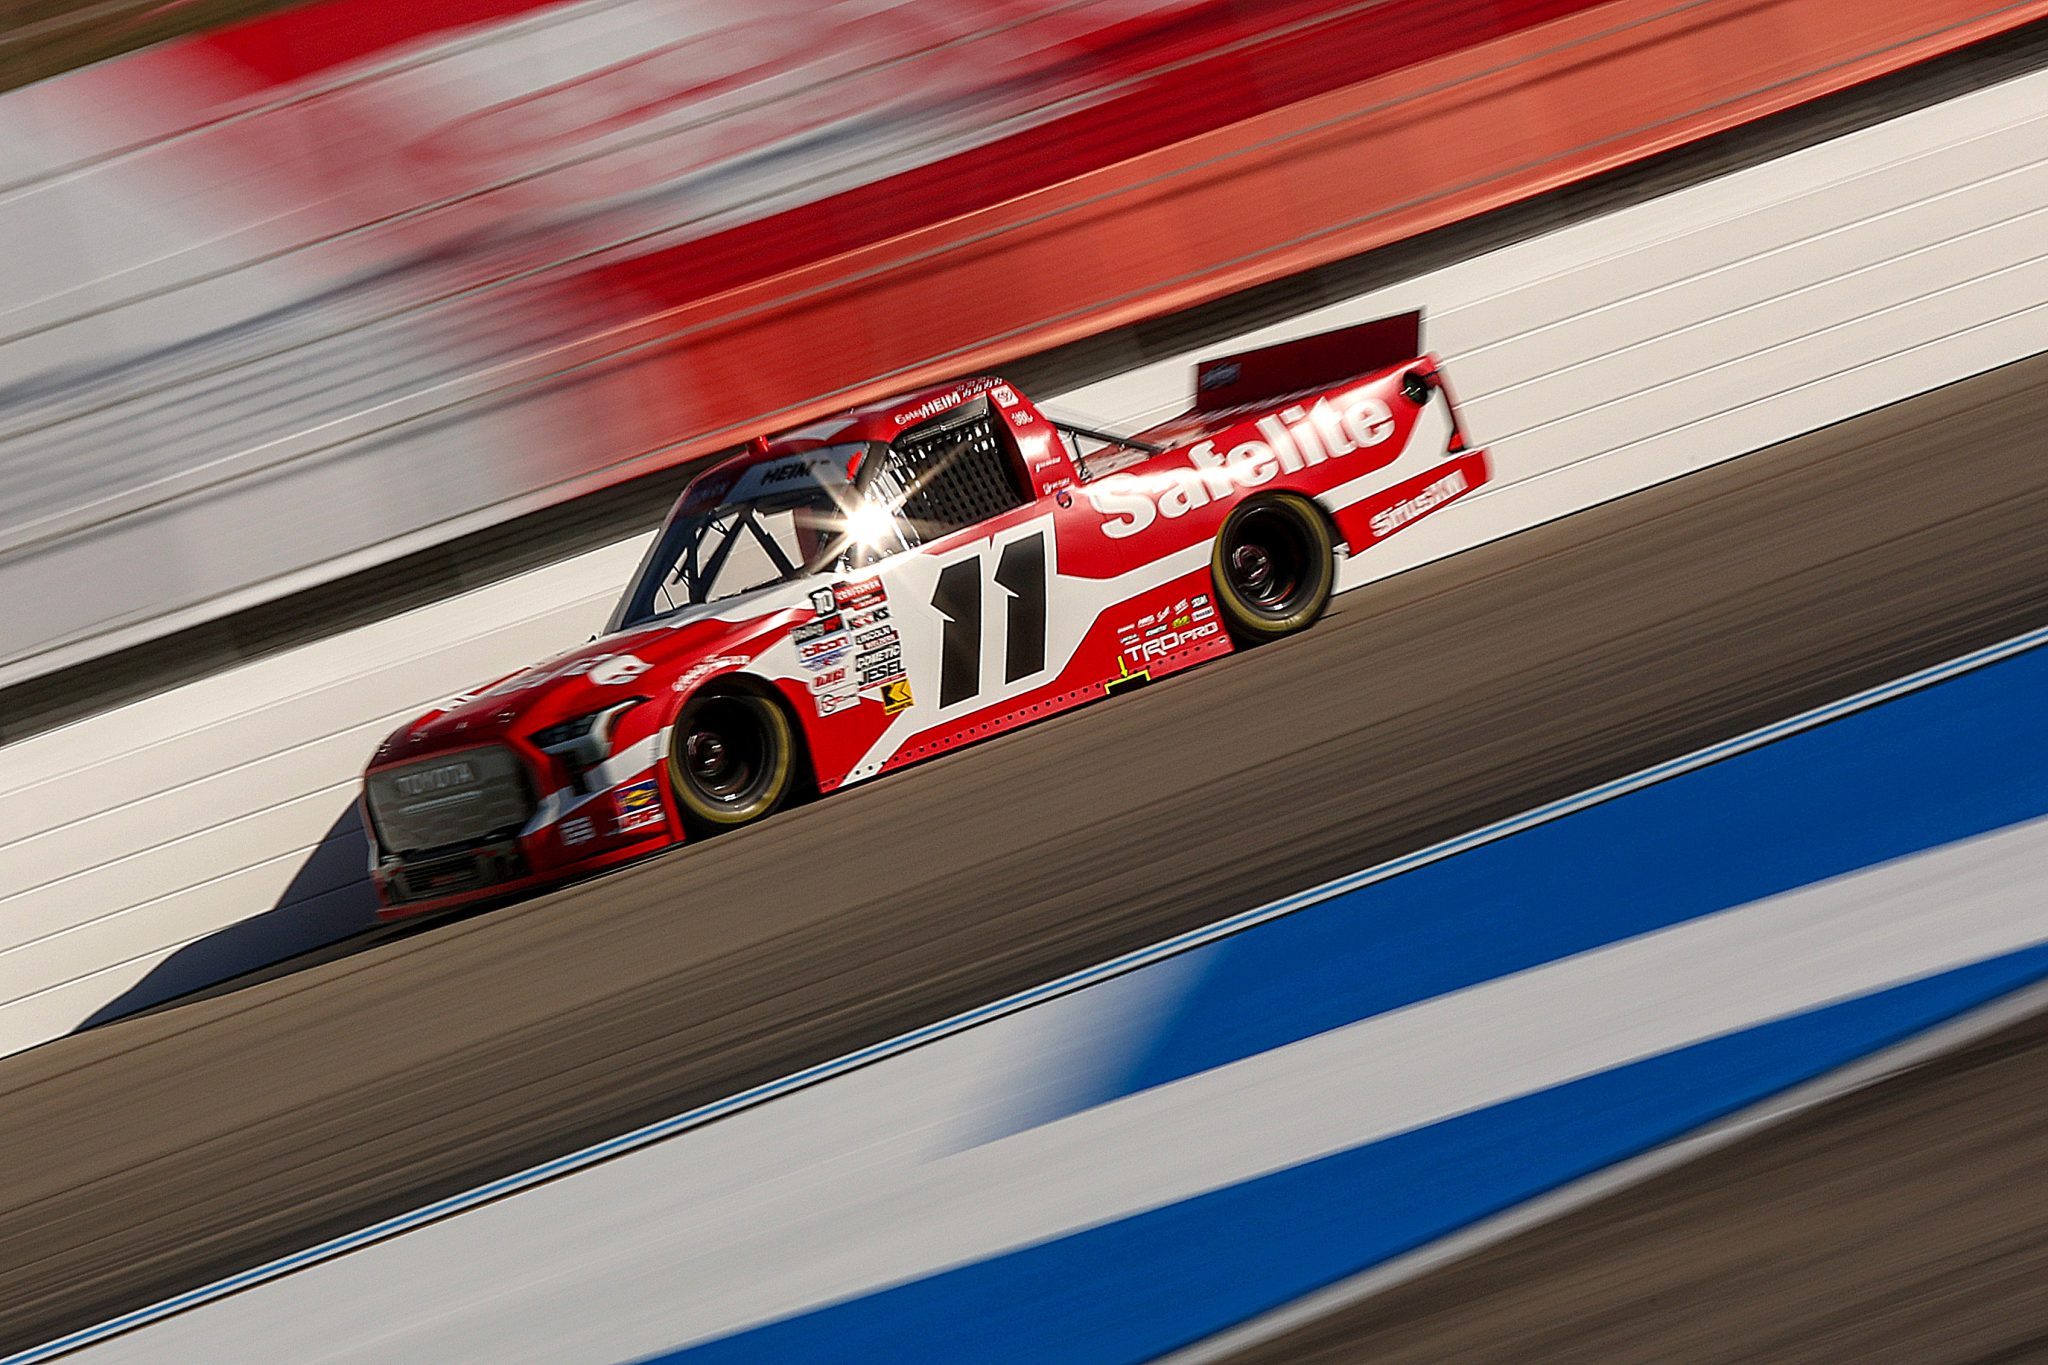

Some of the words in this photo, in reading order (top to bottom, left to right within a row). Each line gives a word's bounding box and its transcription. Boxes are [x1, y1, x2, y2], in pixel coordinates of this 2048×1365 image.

[921, 390, 961, 418] HEIM
[1090, 395, 1396, 539] Safelite
[1368, 469, 1470, 538] SiriusXM
[930, 531, 1046, 709] 11
[1123, 631, 1180, 663] TRD
[1179, 621, 1219, 645] PRO
[857, 659, 906, 686] JESEL
